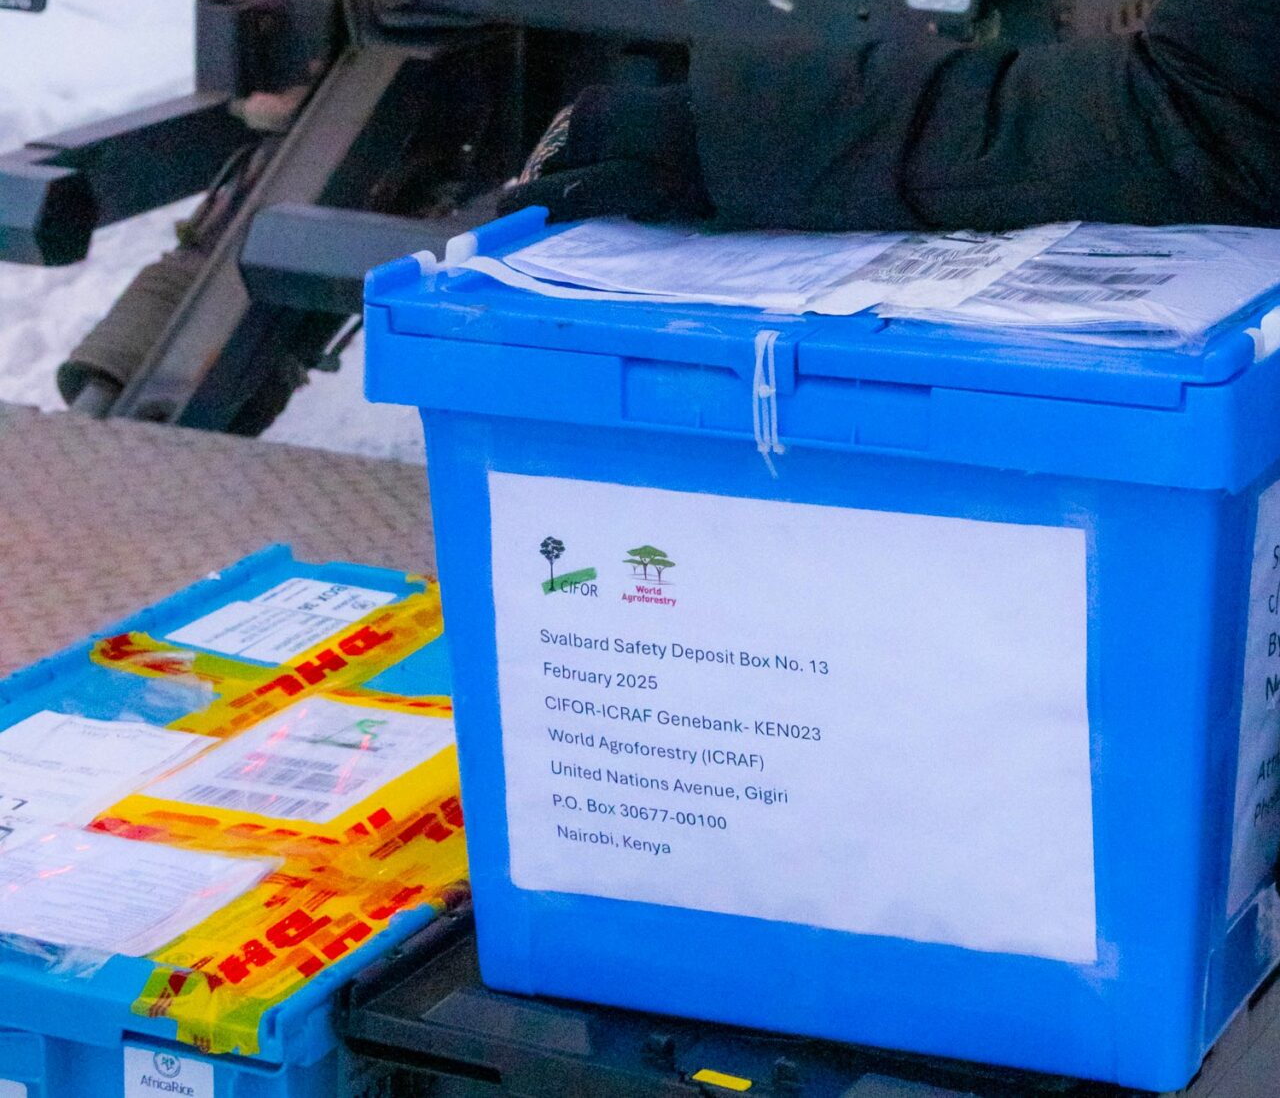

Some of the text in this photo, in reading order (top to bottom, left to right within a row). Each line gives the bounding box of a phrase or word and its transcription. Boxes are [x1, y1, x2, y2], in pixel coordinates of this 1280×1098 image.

[559, 579, 599, 598] CIFOR
[621, 592, 677, 607] Agroforestry
[635, 585, 662, 596] World
[255, 624, 395, 697] DHL
[539, 628, 830, 675] Svalbard Safety Deposit Box No. 13
[542, 661, 659, 690] February 2025
[543, 695, 653, 723] CIFOR-ICRAF
[753, 720, 822, 741] KEN023
[546, 727, 765, 772] World Agroforestry (ICRAF)
[550, 760, 789, 805] United Nations Avenue, Gigiri
[551, 793, 728, 830] P.O. Box 30677-00100
[556, 824, 672, 856] Nairobi, Kenya
[139, 1074, 196, 1097] AfricaRice
